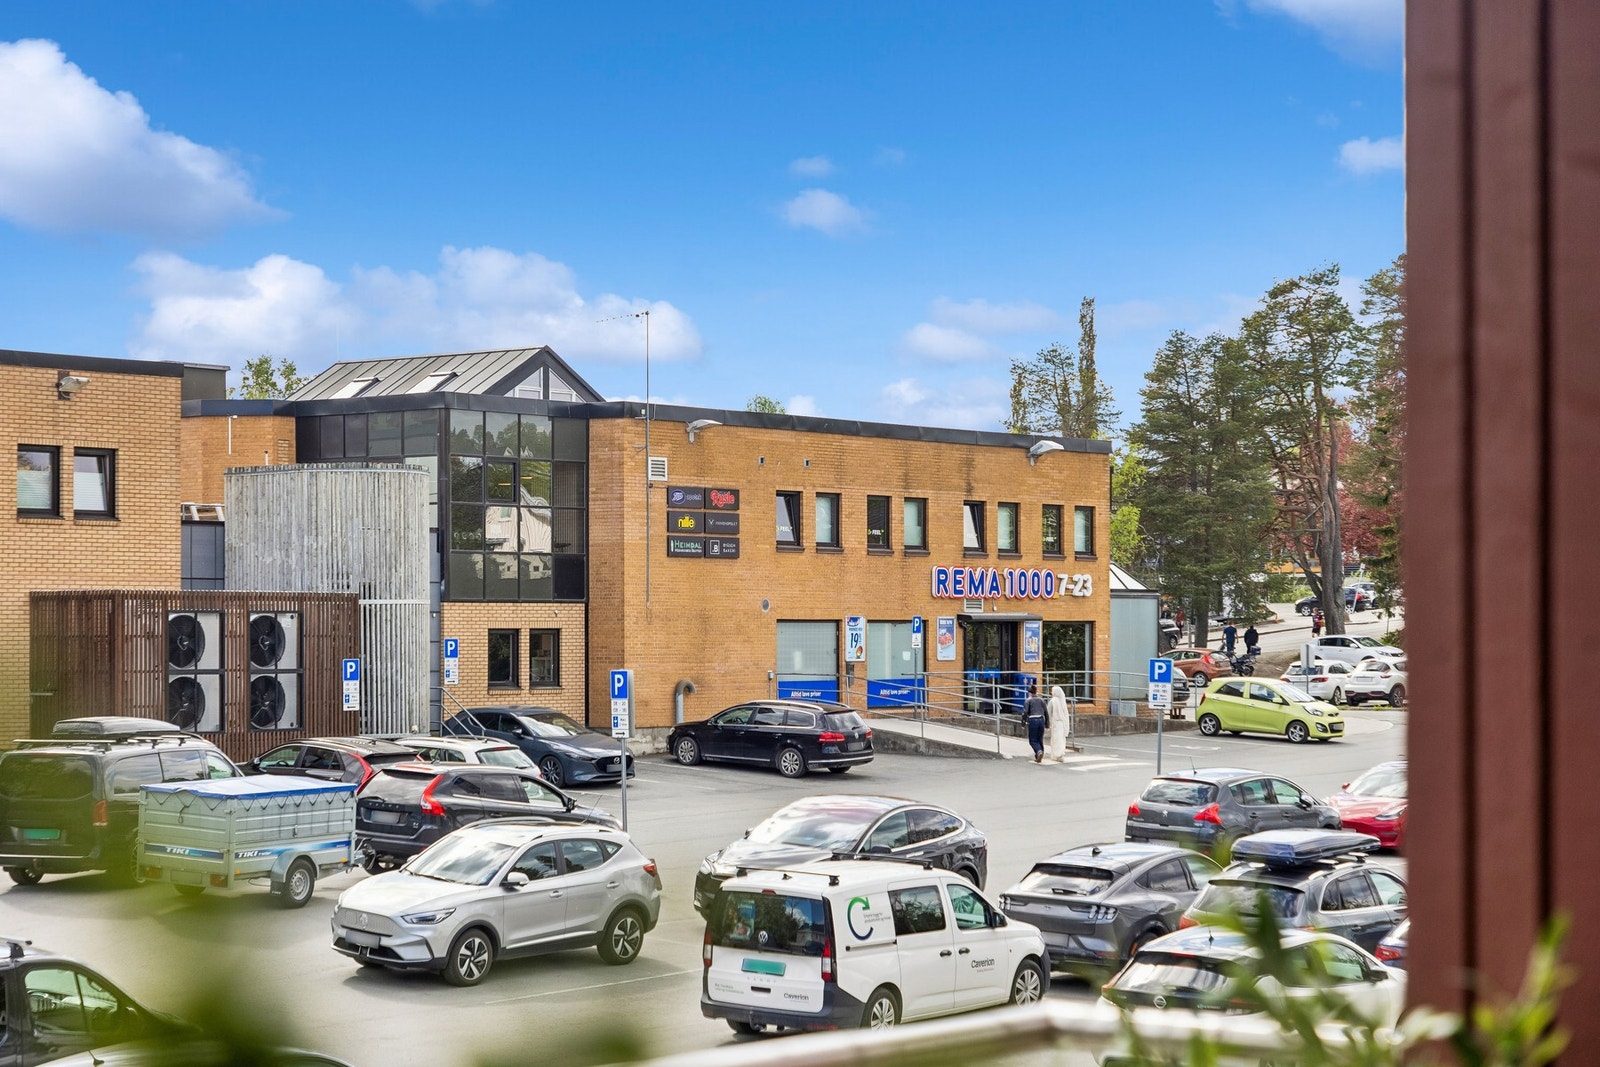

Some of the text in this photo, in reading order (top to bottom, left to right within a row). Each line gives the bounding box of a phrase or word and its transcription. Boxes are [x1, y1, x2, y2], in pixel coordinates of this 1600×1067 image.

[678, 515, 695, 528] nille
[674, 540, 702, 549] HEIMDAL
[932, 565, 1093, 600] REMA 1000 7-23
[914, 618, 920, 632] P
[447, 640, 456, 656] P
[346, 661, 356, 679] P
[1154, 661, 1167, 680] P
[614, 674, 624, 696] P
[165, 847, 189, 855] TIKI
[238, 850, 258, 858] TIKI
[971, 958, 995, 968] Caverion
[783, 992, 809, 1001] Caverion
